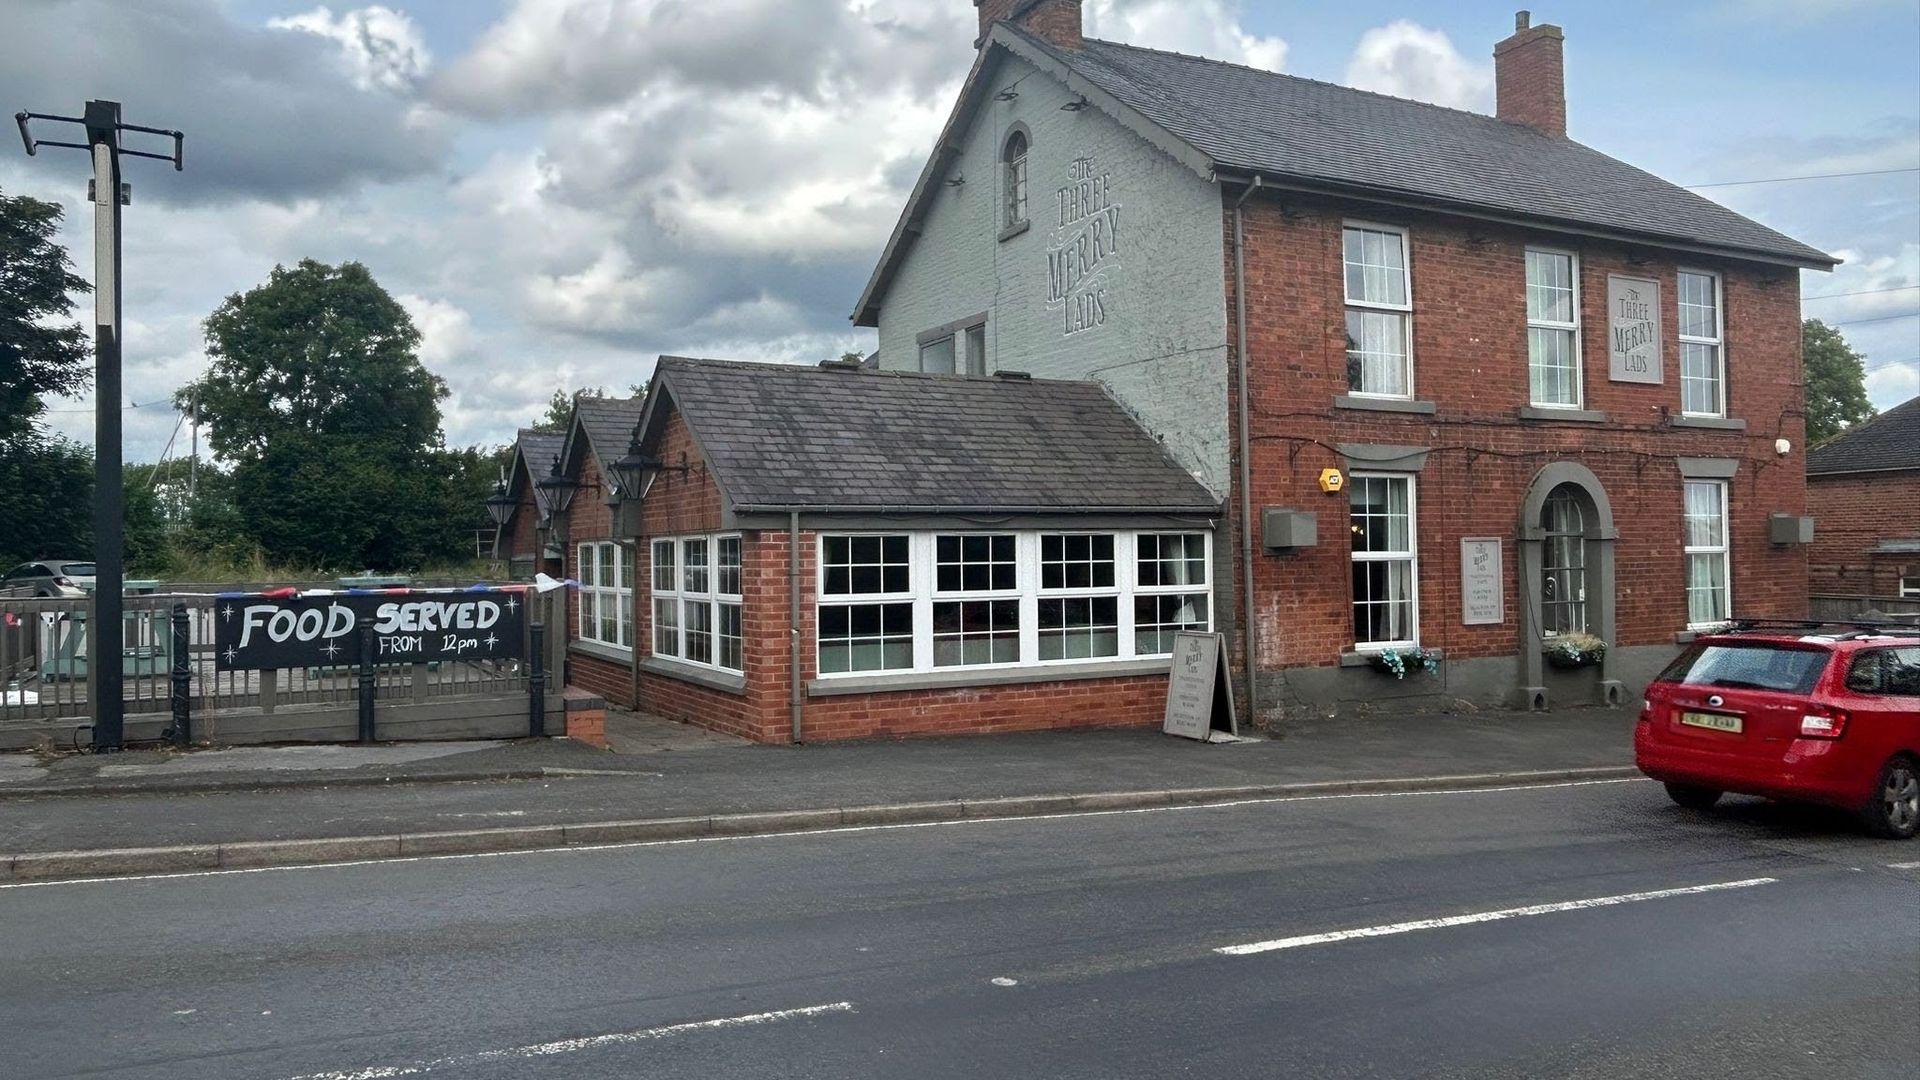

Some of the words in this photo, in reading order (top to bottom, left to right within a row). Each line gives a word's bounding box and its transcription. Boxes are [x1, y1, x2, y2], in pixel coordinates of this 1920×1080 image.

[1056, 173, 1110, 229] THREE
[1047, 206, 1120, 303] MERRY
[1063, 288, 1105, 336] LADS
[1618, 298, 1649, 321] THREE
[1614, 321, 1654, 353] MERRY
[1624, 352, 1648, 373] LADS
[238, 603, 356, 648] FOOD
[372, 600, 500, 634] SERVED
[378, 635, 423, 655] FROM
[440, 633, 478, 654] 12pm
